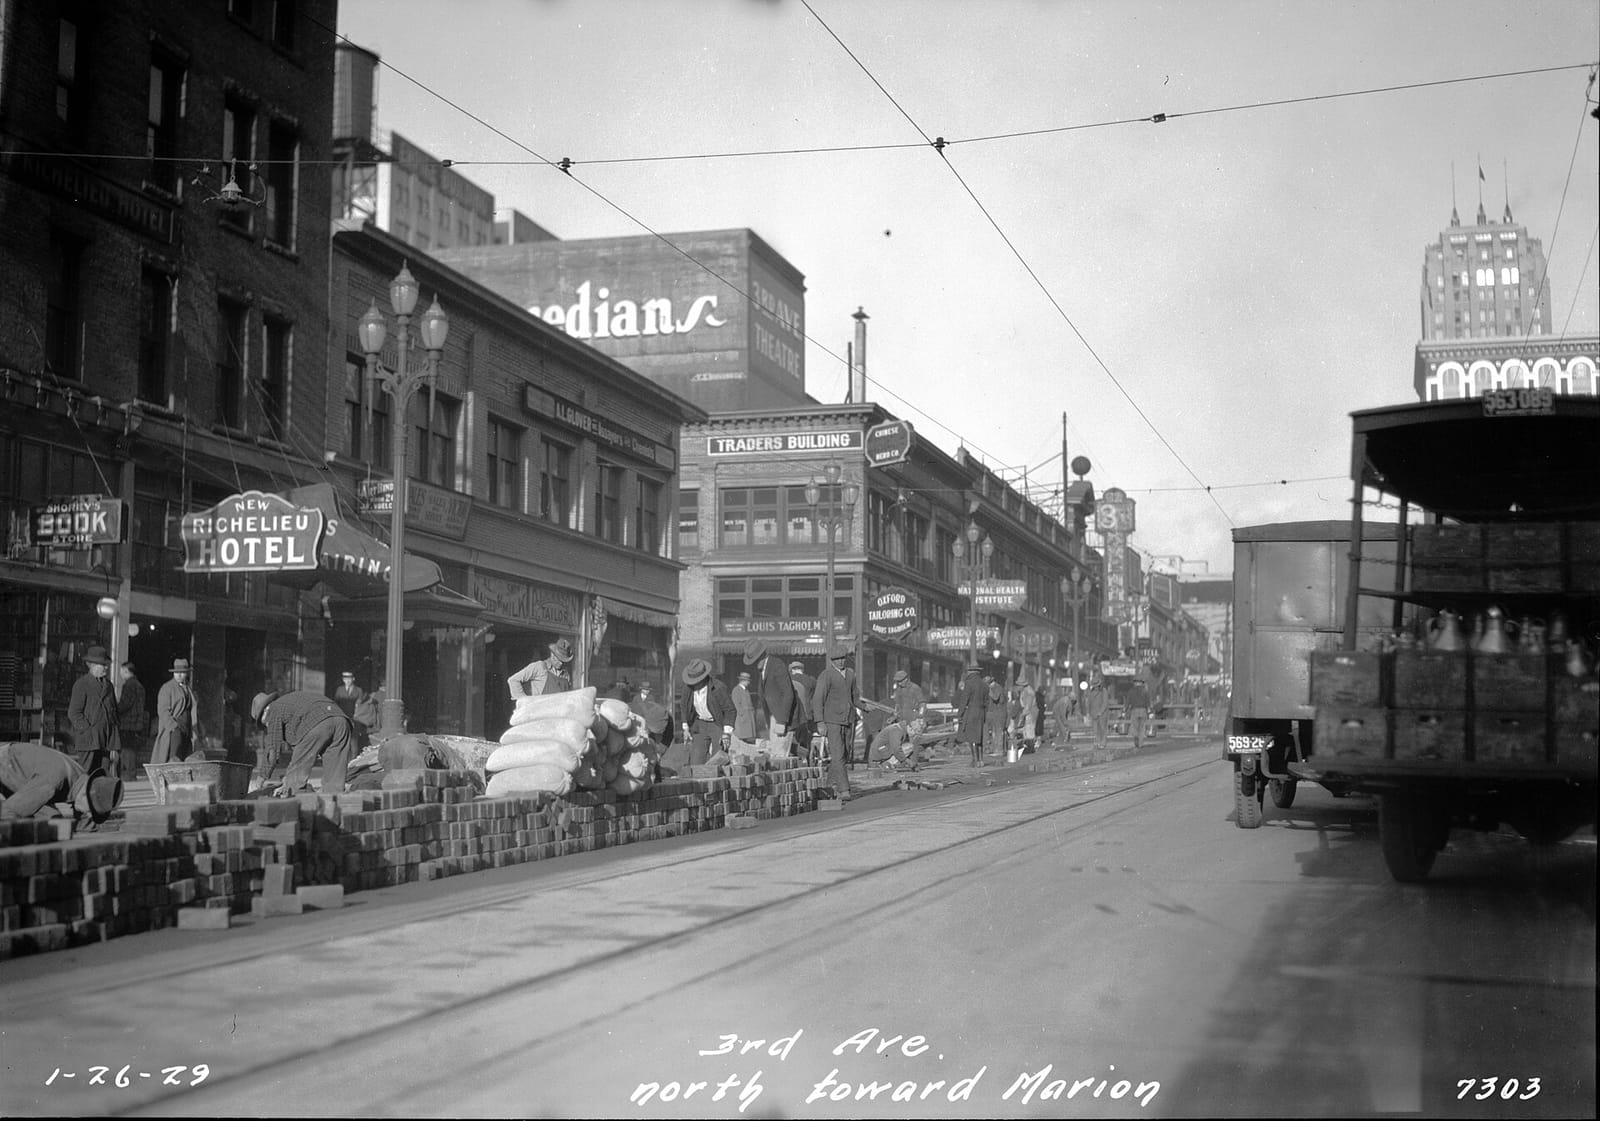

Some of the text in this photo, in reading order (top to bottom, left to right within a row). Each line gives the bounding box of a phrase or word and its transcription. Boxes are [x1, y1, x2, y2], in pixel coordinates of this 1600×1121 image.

[775, 299, 803, 341] AVE
[754, 322, 801, 379] THEATRE
[874, 426, 899, 438] CHINESE
[716, 434, 851, 452] TRADERS BUILDING
[235, 499, 270, 512] NEW
[38, 511, 107, 536] BOOK
[192, 514, 308, 533] RICHELIEU
[53, 534, 94, 544] STORE
[199, 536, 305, 566] HOTEL
[958, 586, 1025, 596] NATONAL HEALTH
[877, 593, 906, 607] OXFORD
[868, 606, 917, 621] TAILORING CO.
[747, 622, 775, 632] LOUIS
[778, 621, 821, 632] TAGHOLM
[942, 637, 971, 647] CHINA
